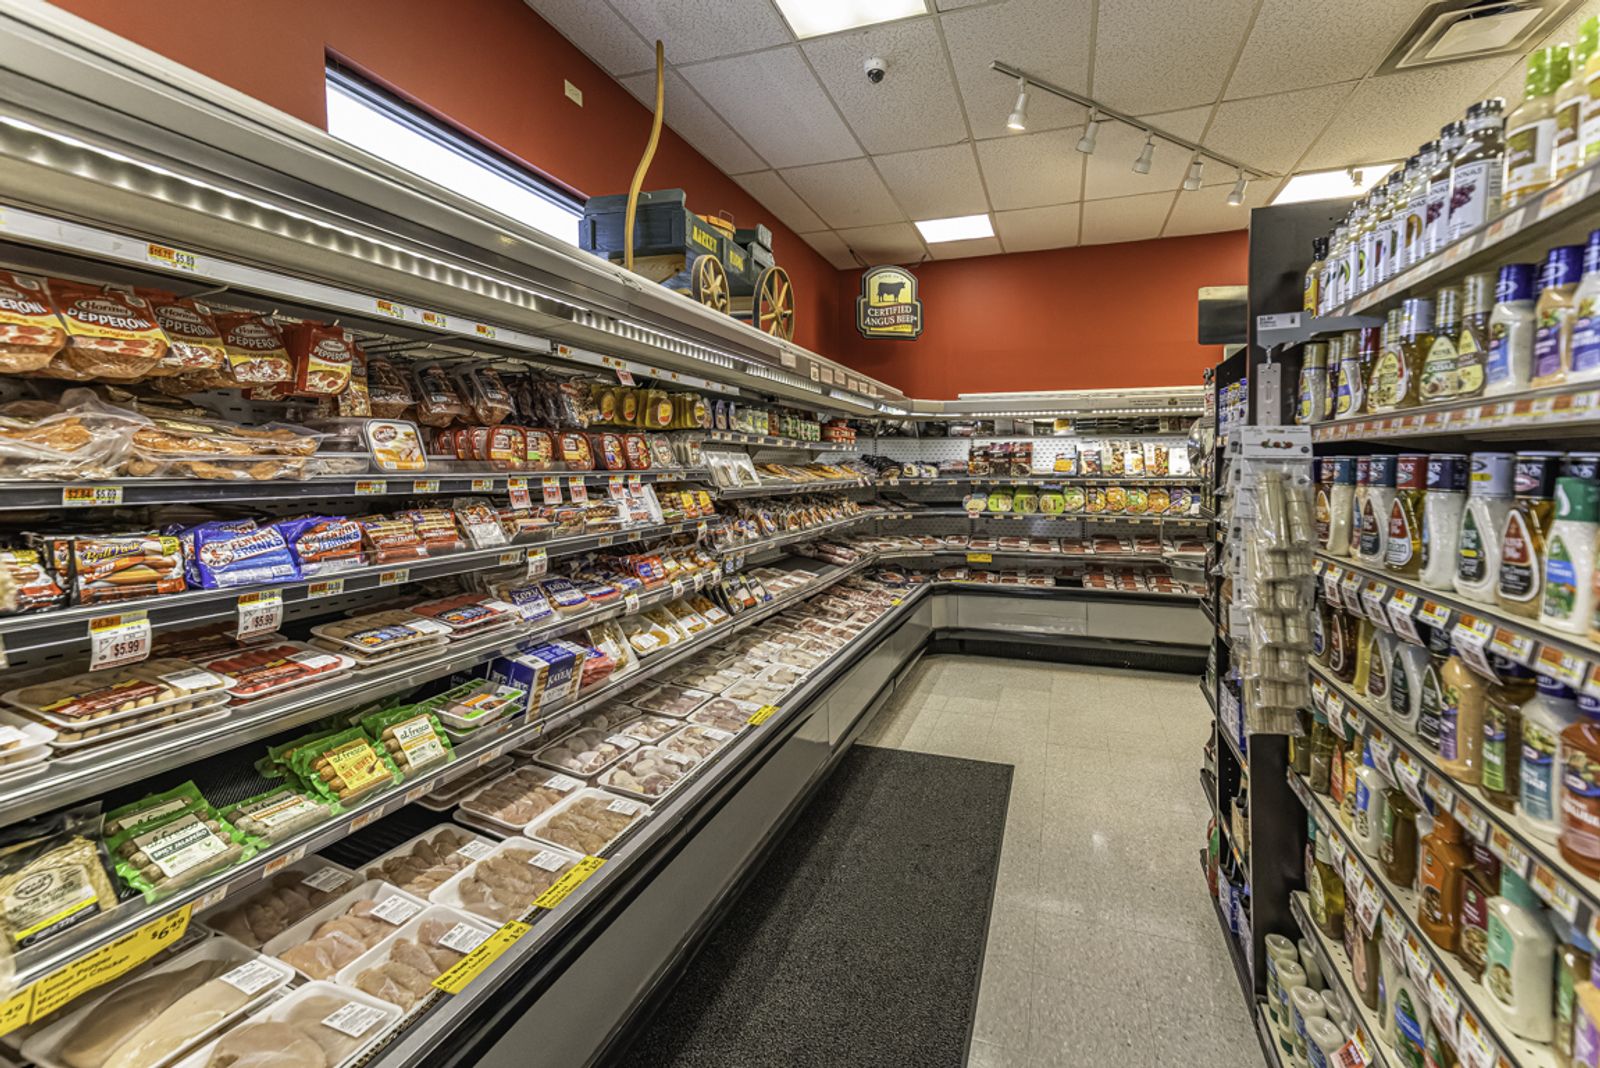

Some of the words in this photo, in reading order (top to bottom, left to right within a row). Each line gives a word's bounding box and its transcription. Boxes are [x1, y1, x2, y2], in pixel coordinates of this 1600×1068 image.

[86, 300, 130, 316] Hormel
[867, 305, 912, 317] CERTIFIED
[67, 307, 152, 331] PEPPERONI
[864, 315, 895, 326] ANGUS
[896, 314, 914, 325] BEEF
[235, 536, 284, 559] FRANKS
[319, 531, 360, 550] FRANKS
[255, 614, 274, 628] $5.99
[114, 640, 139, 657] $5.99
[400, 729, 410, 740] al
[409, 724, 430, 738] fresco
[343, 745, 367, 760] fresco
[89, 954, 130, 976] Chicken
[443, 970, 469, 990] Chicken
[468, 952, 491, 970] Tenders
